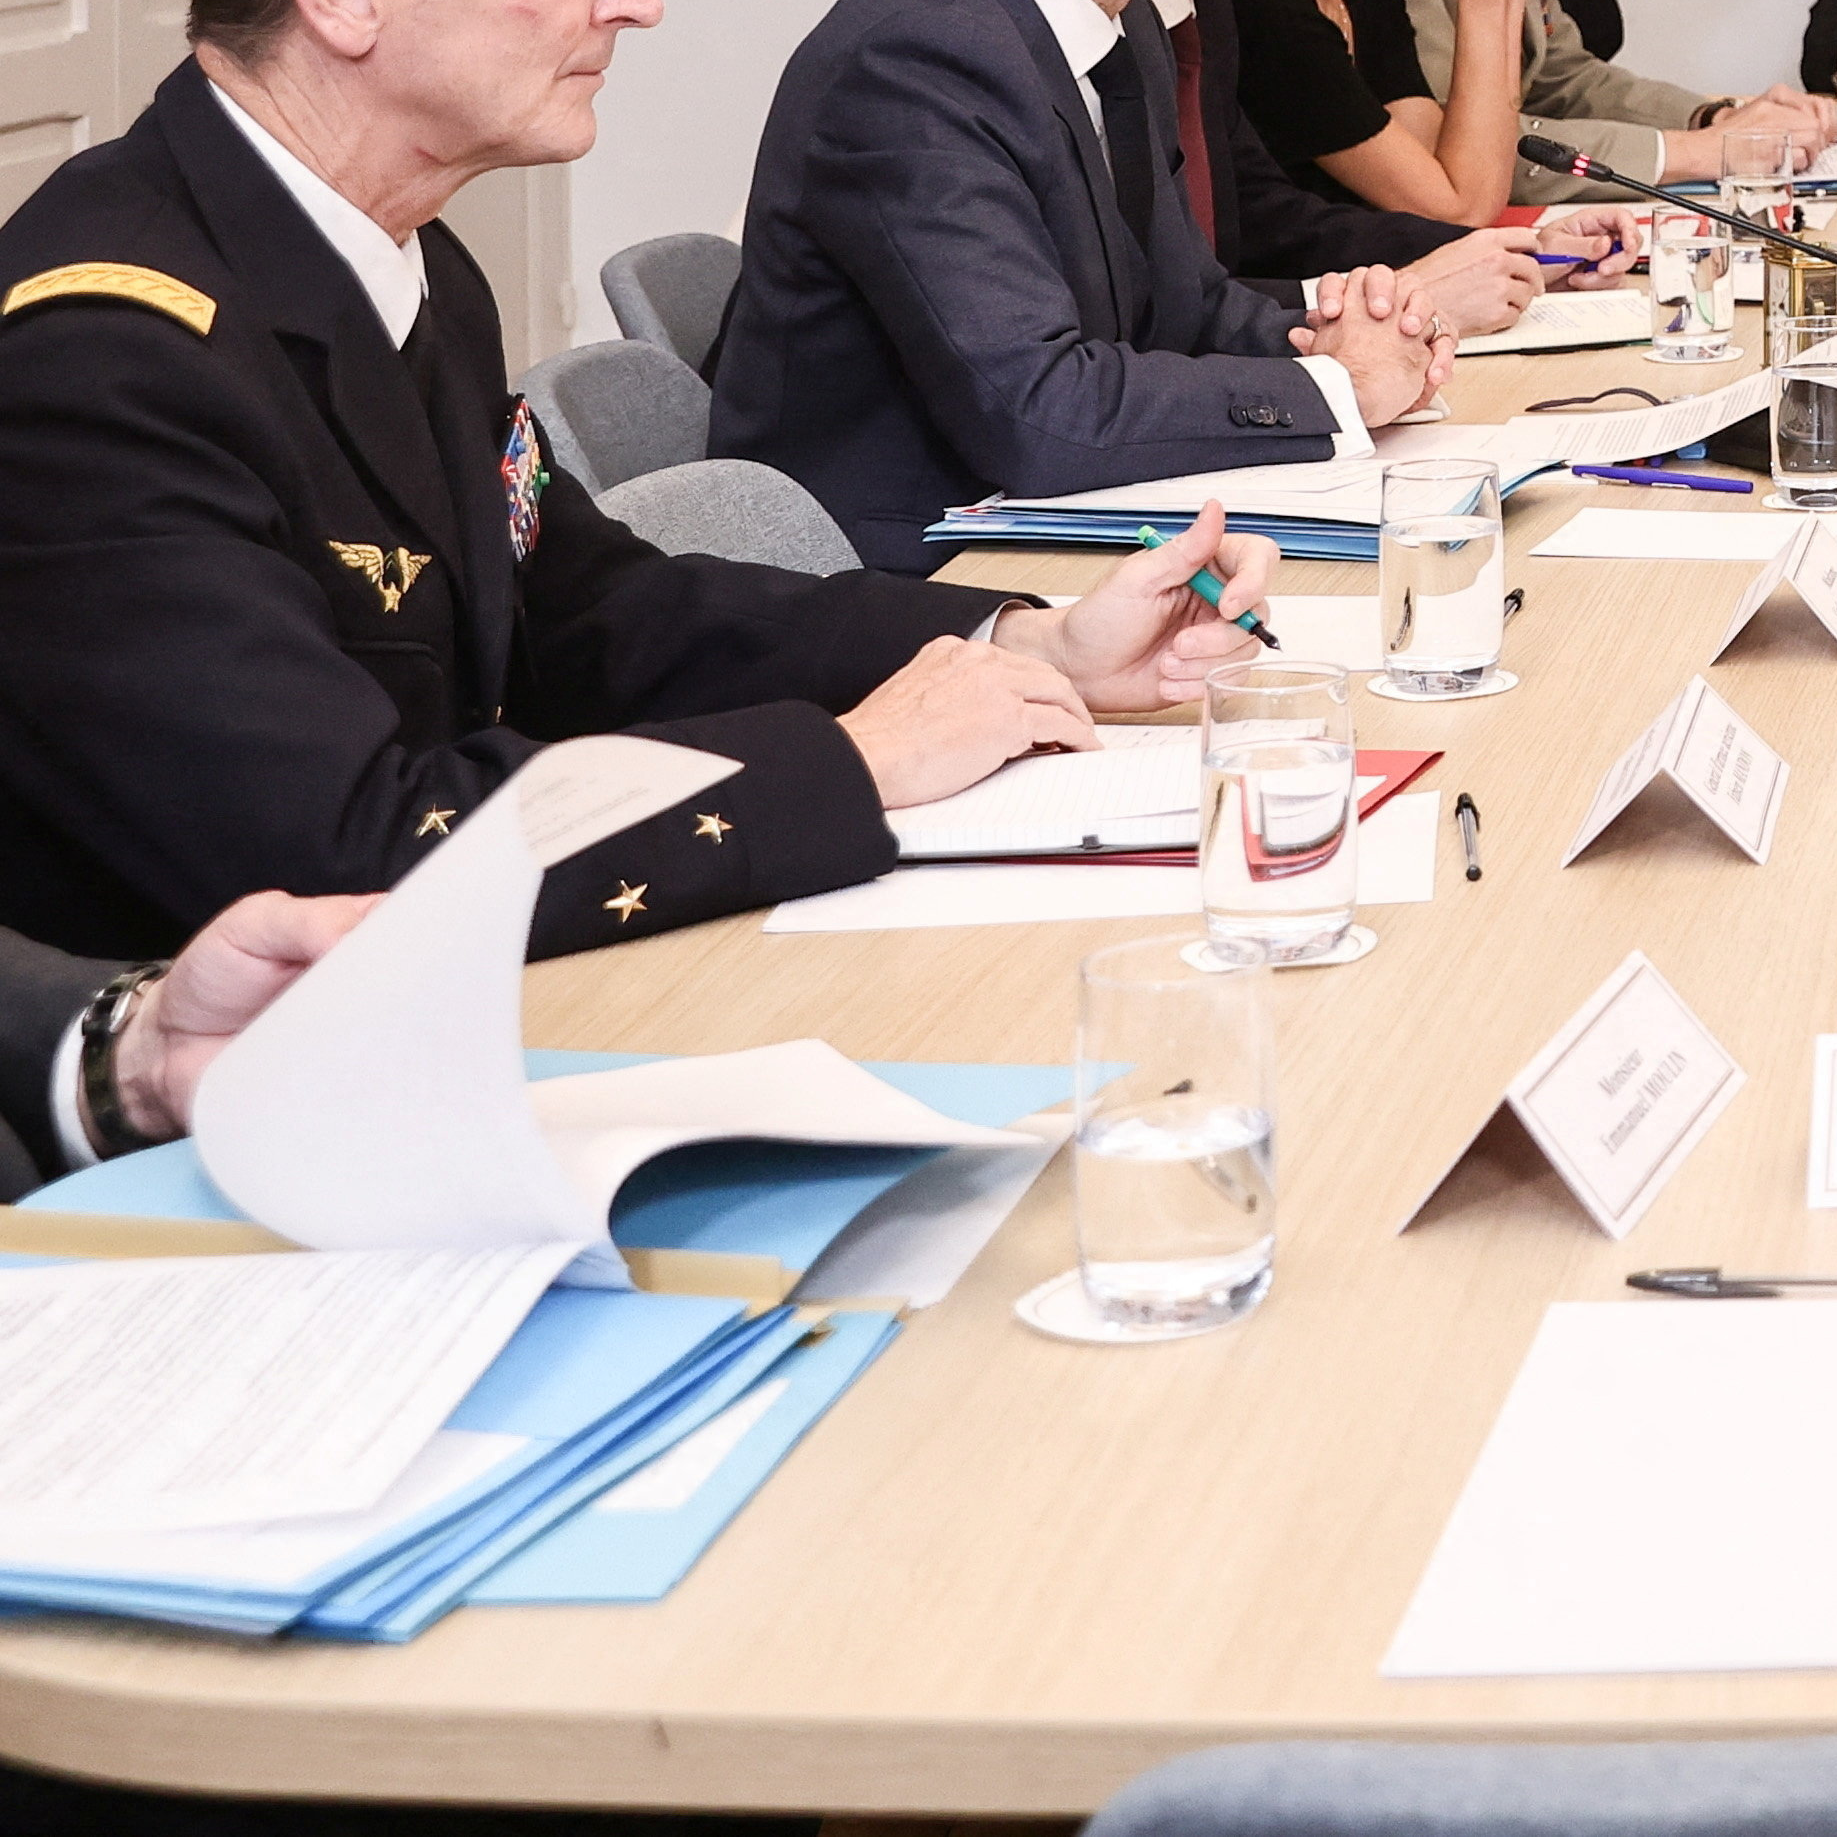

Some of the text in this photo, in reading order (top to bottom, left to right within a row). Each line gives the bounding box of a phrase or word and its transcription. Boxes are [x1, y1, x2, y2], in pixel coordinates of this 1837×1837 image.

[1598, 1049, 1644, 1098] Monsieur
[1599, 1049, 1688, 1156] Emmanuel MOULIN
